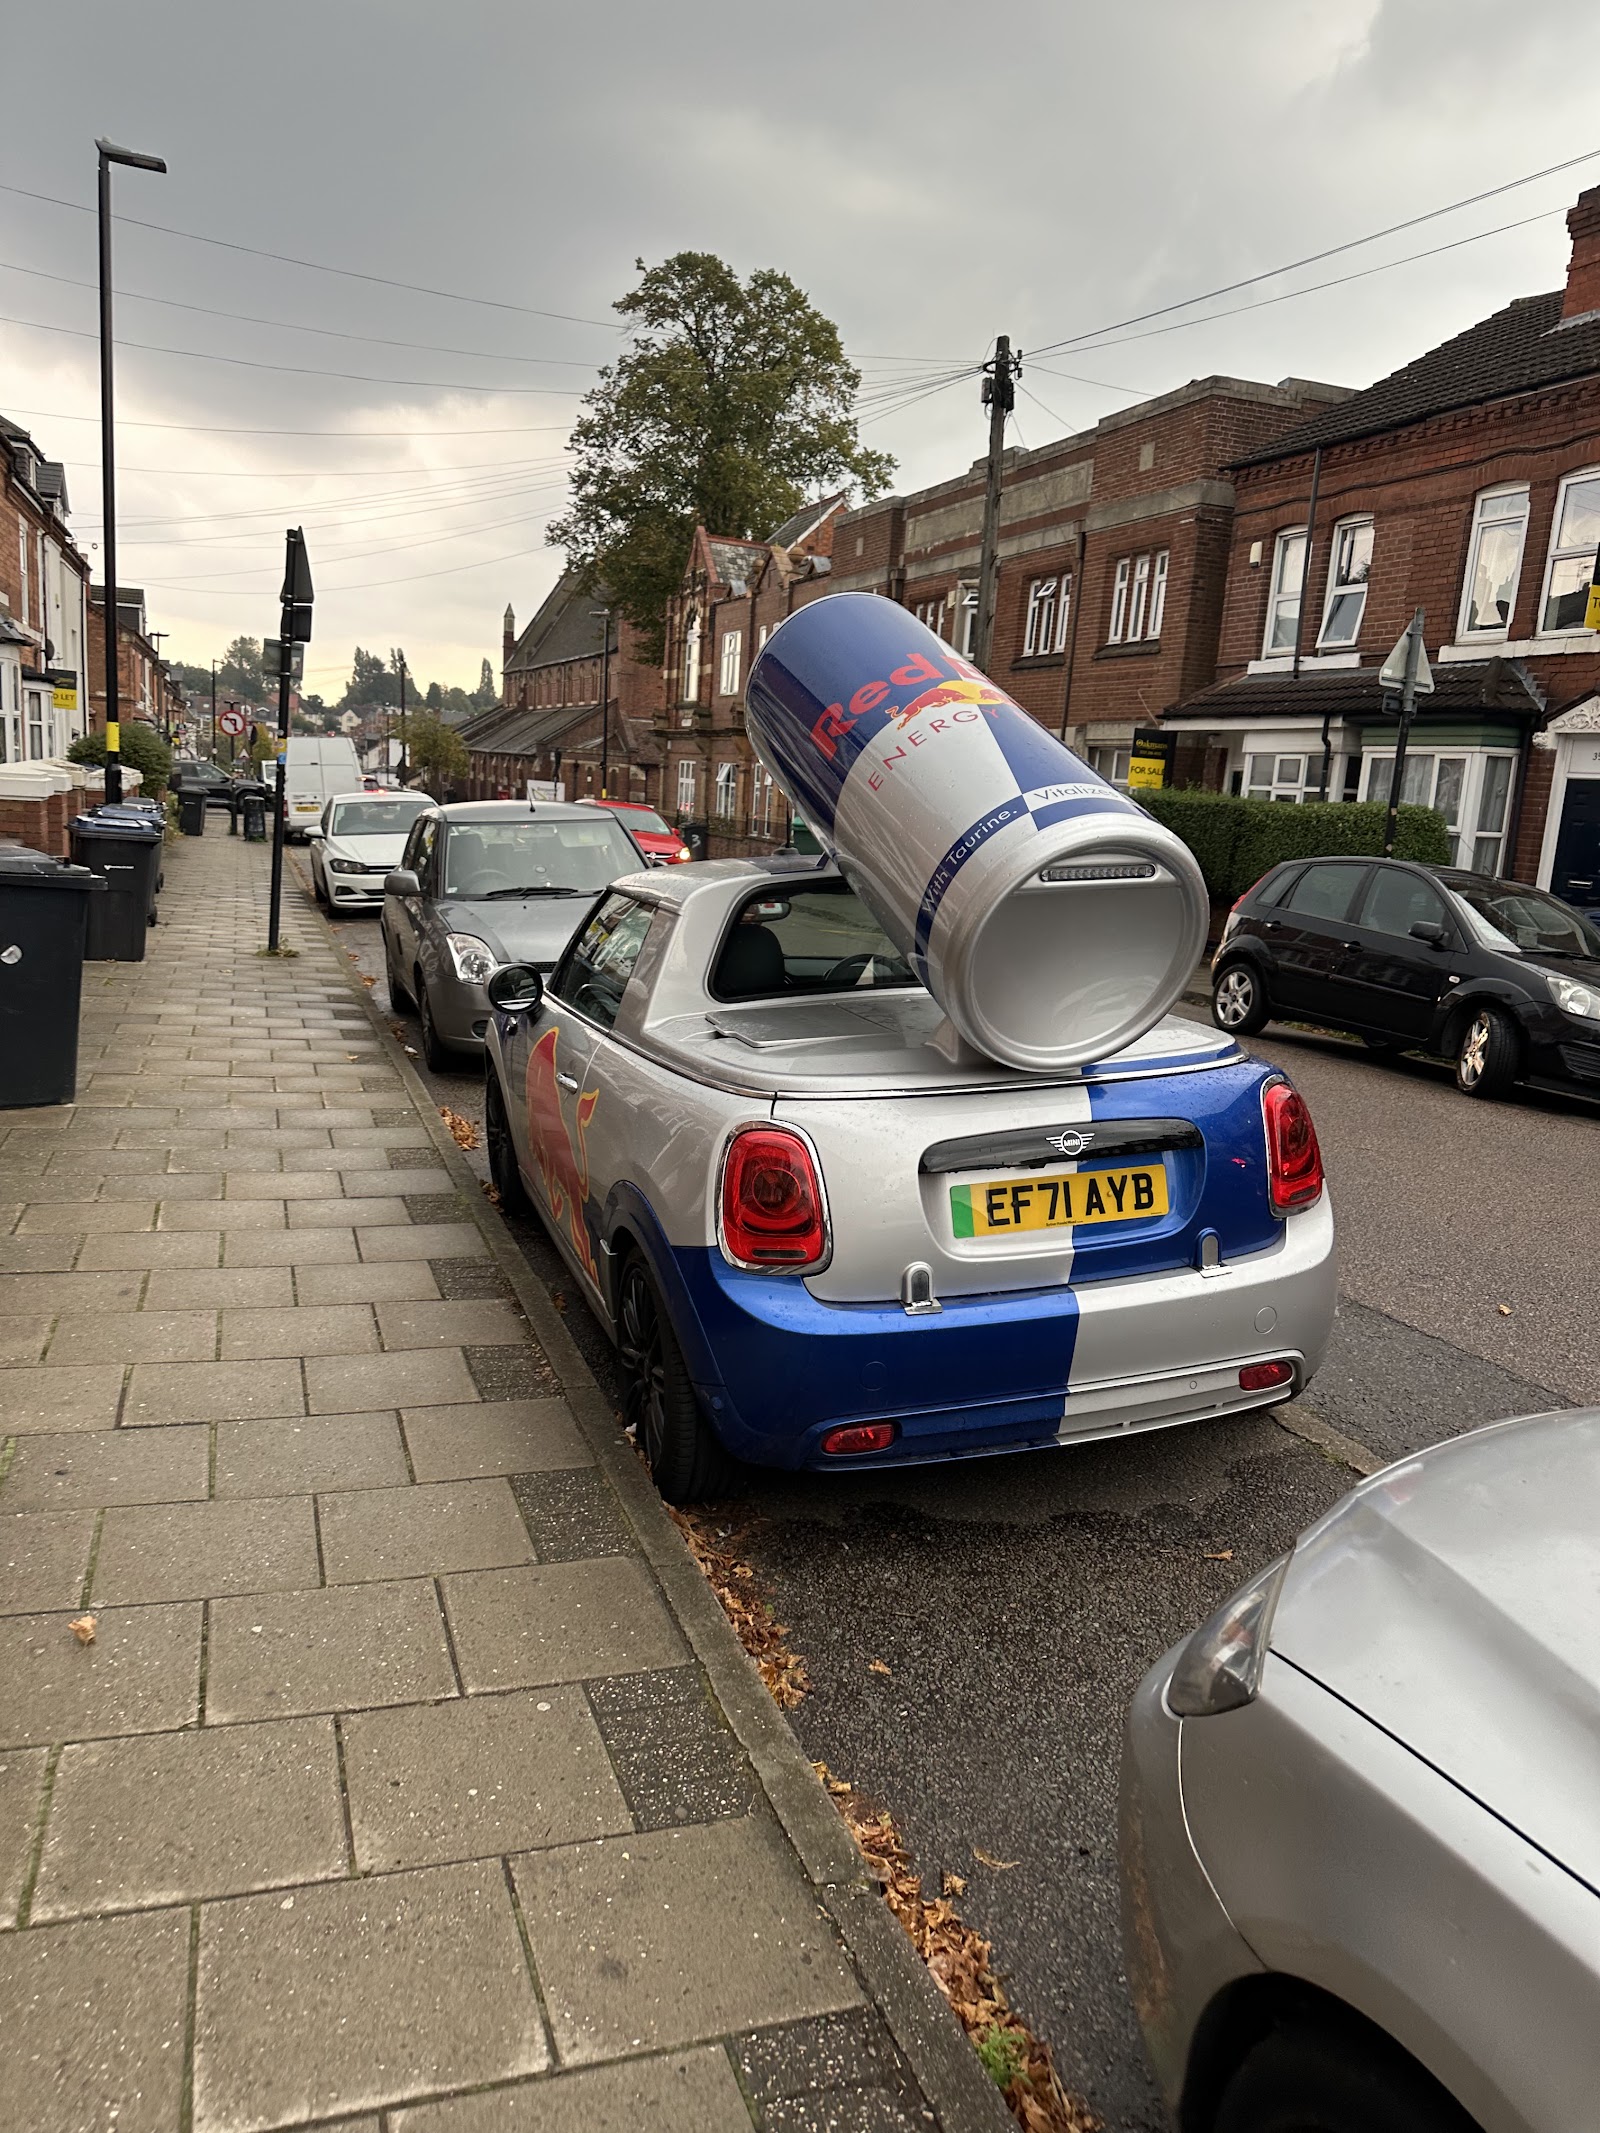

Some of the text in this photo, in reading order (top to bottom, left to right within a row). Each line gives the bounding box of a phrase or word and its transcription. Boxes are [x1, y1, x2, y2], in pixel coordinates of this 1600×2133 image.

[1592, 596, 1600, 609] T
[809, 653, 945, 761] Red
[867, 707, 999, 791] ENERGY
[1130, 766, 1146, 774] FOR
[1034, 785, 1119, 801] Vitalizes
[691, 834, 701, 848] 3
[922, 809, 1018, 913] With Taurine.
[1063, 1138, 1081, 1147] MINI
[986, 1173, 1154, 1227] EF71 AYB
